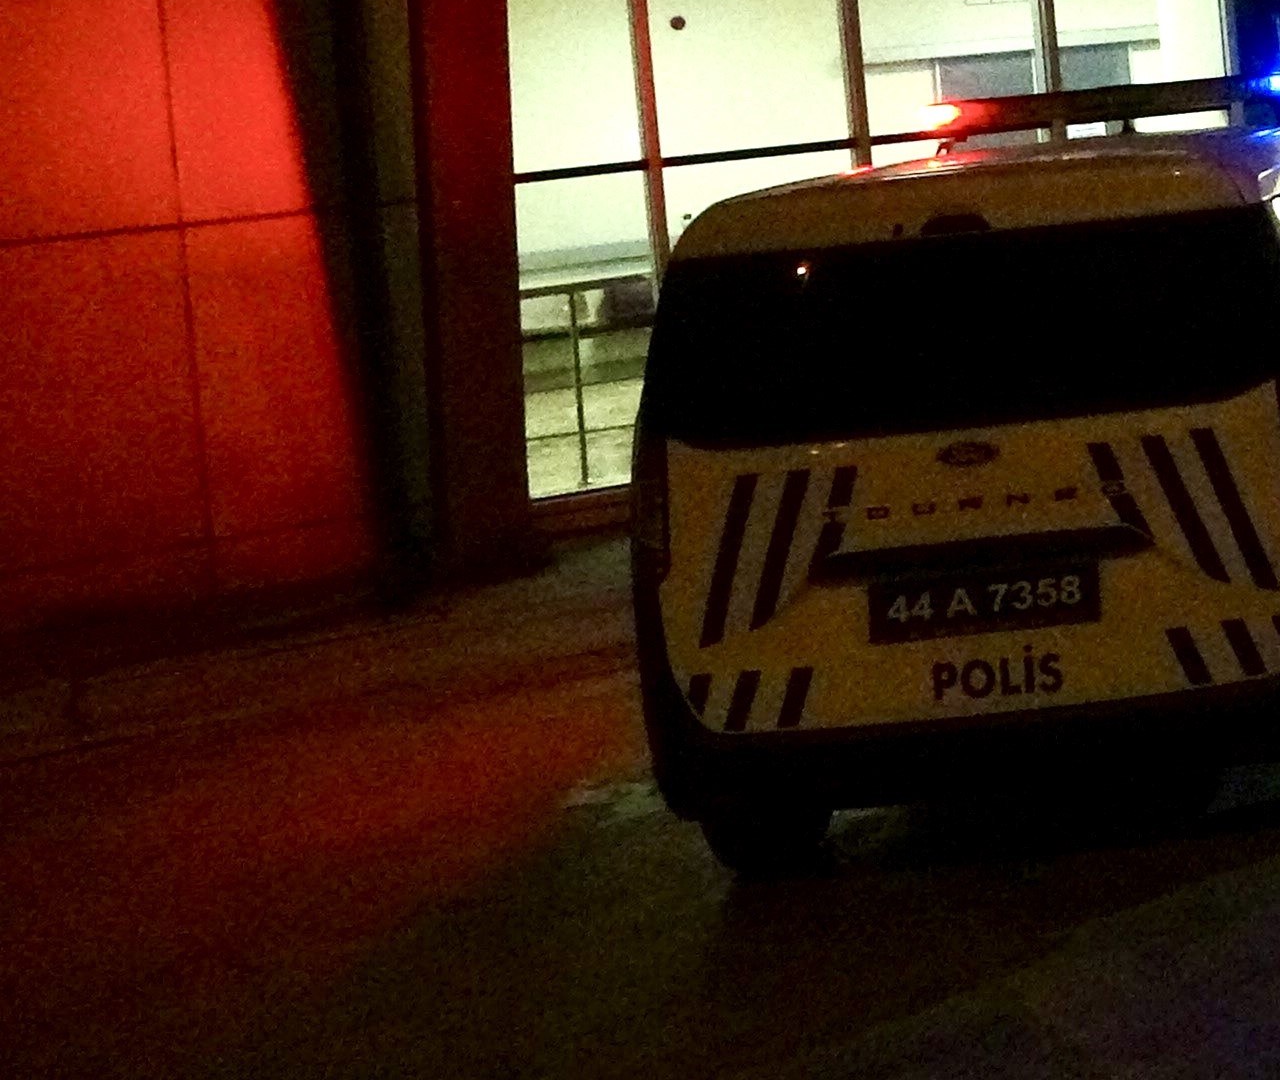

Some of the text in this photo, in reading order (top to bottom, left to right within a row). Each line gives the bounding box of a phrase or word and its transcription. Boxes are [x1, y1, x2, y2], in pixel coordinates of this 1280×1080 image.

[887, 575, 1082, 622] 44 A 7358
[931, 644, 1063, 700] POLİS
